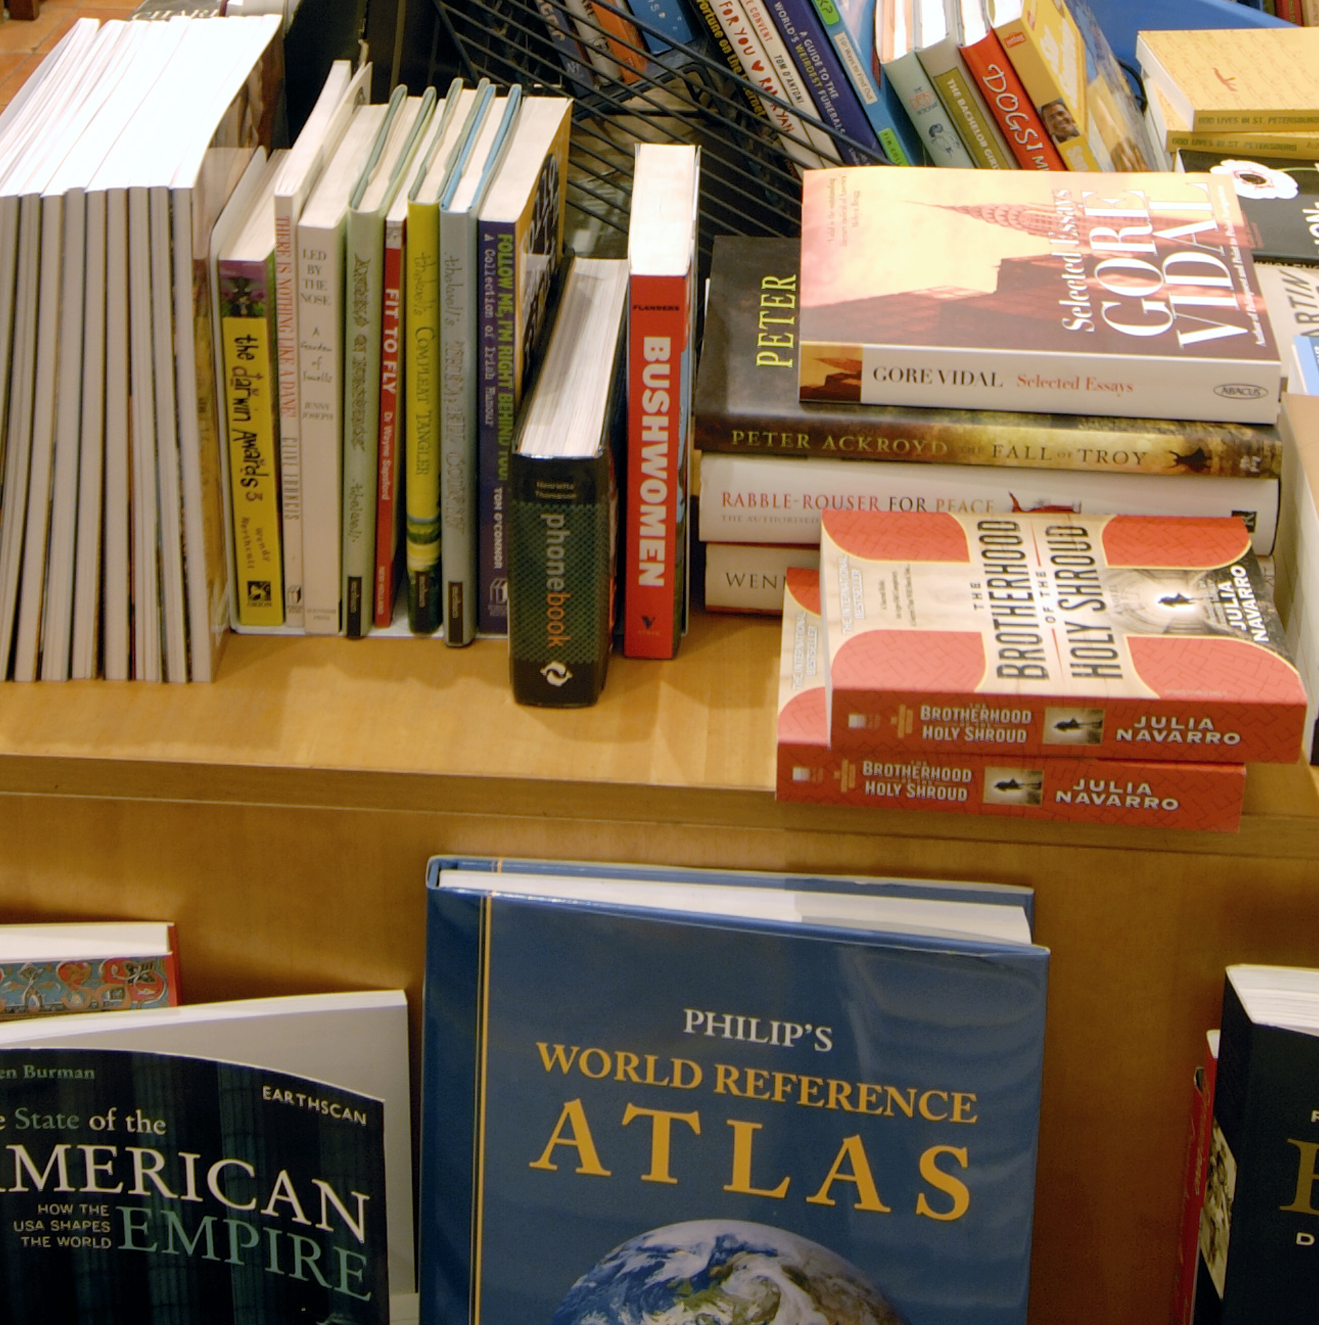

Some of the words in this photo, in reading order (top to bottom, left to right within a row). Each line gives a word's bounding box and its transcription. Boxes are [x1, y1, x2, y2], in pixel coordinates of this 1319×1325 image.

[982, 64, 1038, 145] DOGS
[1049, 189, 1080, 245] Essays
[1081, 189, 1174, 336] GORE
[1149, 182, 1248, 348] VIDAL
[1052, 252, 1095, 333] Selected
[756, 274, 797, 369] PETER
[233, 334, 257, 361] the
[231, 365, 262, 423] darwin
[873, 366, 934, 386] GORE
[935, 369, 1003, 389] VIDAL
[1016, 374, 1080, 392] Selected
[1084, 376, 1133, 395] Essays
[1220, 385, 1264, 398] ABACUS
[231, 429, 270, 490] Awards
[639, 335, 673, 588] BUSHWOMEN
[730, 429, 811, 450] PETER
[821, 435, 949, 456] ACKROYD
[992, 444, 1053, 462] FALL
[1078, 448, 1149, 467] TROY
[244, 490, 263, 503] 3
[721, 491, 880, 512] RABBLE-ROUSER
[889, 496, 927, 513] FOR
[934, 498, 995, 514] PEACE
[540, 514, 572, 650] phonebook
[1045, 524, 1108, 613] SHROUD
[978, 520, 1050, 680] BROTHERHOOD
[1218, 580, 1245, 630] JULIA
[1229, 565, 1270, 643] NAVARRO
[1065, 621, 1124, 680] HOLY
[920, 706, 1032, 725] BROTHERHOOD
[922, 725, 960, 741] HOLY
[965, 727, 1027, 743] SHROUD
[1134, 715, 1214, 730] JULIA
[1117, 729, 1241, 745] NAVARRO
[862, 761, 972, 782] BROTHERHOOD
[865, 781, 902, 797] HOLY
[906, 783, 968, 802] SHROUD
[1074, 779, 1152, 795] JULIA
[1056, 790, 1179, 811] NAVARRO
[683, 1007, 833, 1053] PHILIP'S
[23, 1065, 95, 1080] Burman
[536, 1042, 705, 1090] WORLD
[714, 1064, 979, 1124] REFERENCE
[15, 1107, 79, 1130] State
[89, 1107, 118, 1131] of
[125, 1110, 167, 1136] the
[262, 1085, 367, 1127] EARTHSCAN
[529, 1097, 972, 1223] ATLAS
[13, 1220, 44, 1232] USA
[49, 1220, 111, 1233] SHAPES
[37, 1203, 74, 1215] HOW
[79, 1203, 109, 1217] THE
[21, 1236, 51, 1247] THE
[57, 1235, 112, 1249] WORLD
[116, 1204, 372, 1302] EMPIRE
